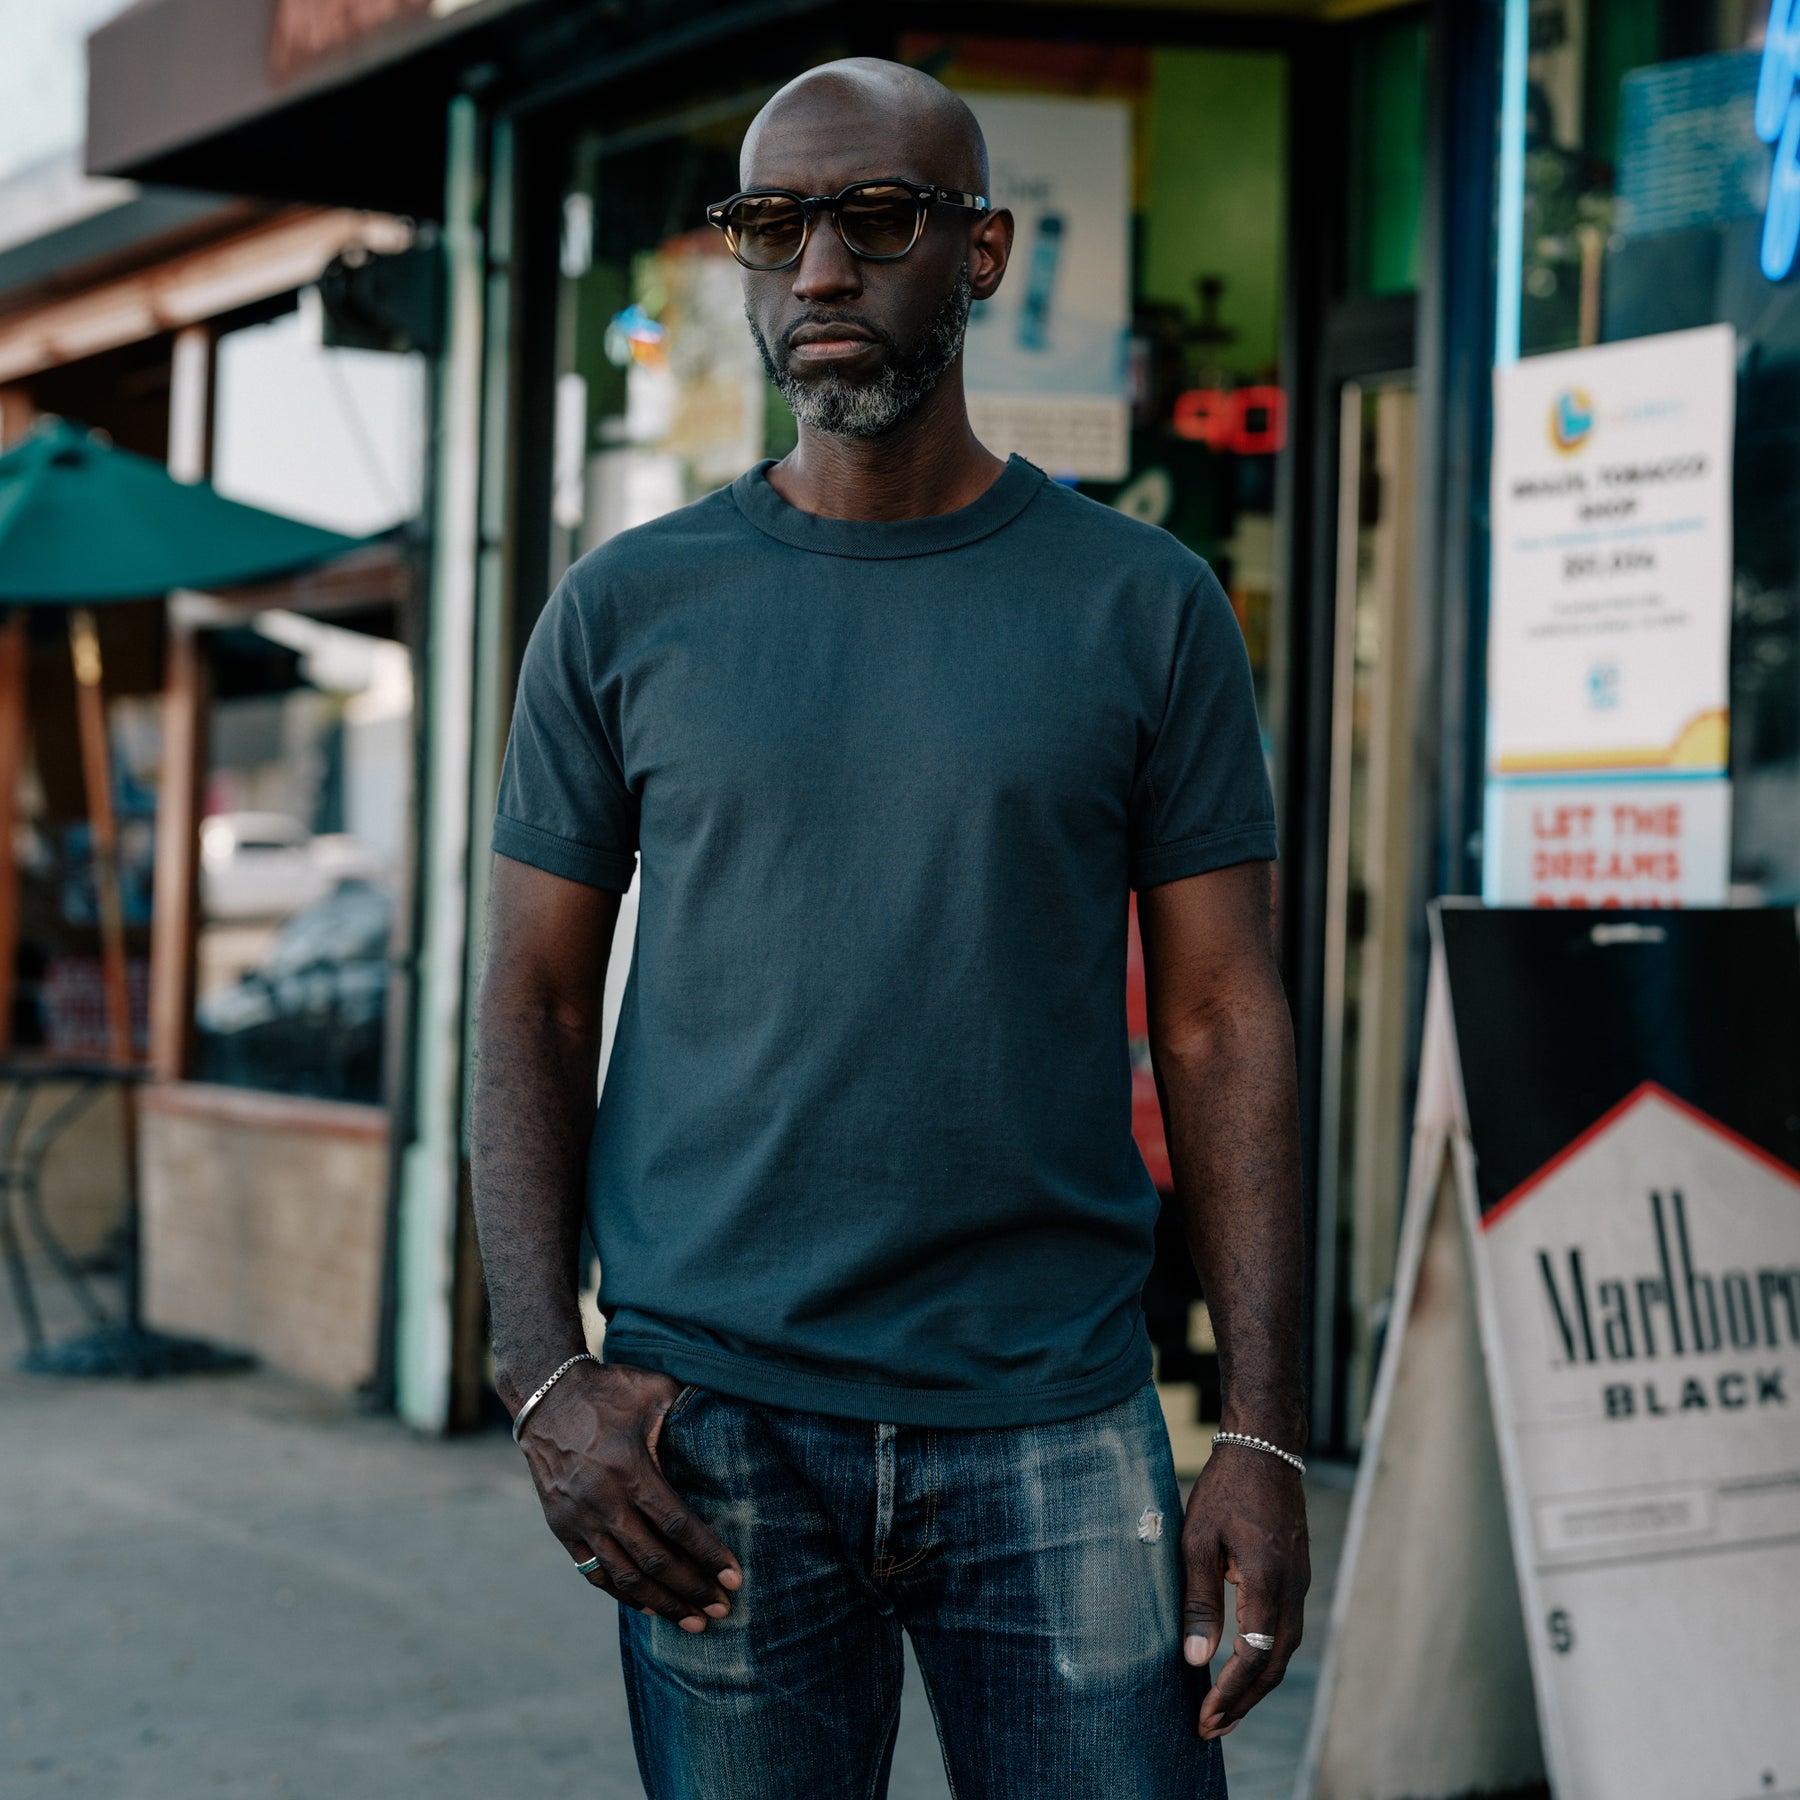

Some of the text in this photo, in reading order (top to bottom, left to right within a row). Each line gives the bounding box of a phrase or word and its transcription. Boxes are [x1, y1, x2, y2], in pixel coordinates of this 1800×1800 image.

[1533, 805, 1681, 838] LET THE
[1533, 852, 1681, 881] DREAMS
[1604, 1368, 1787, 1419] BLACK
